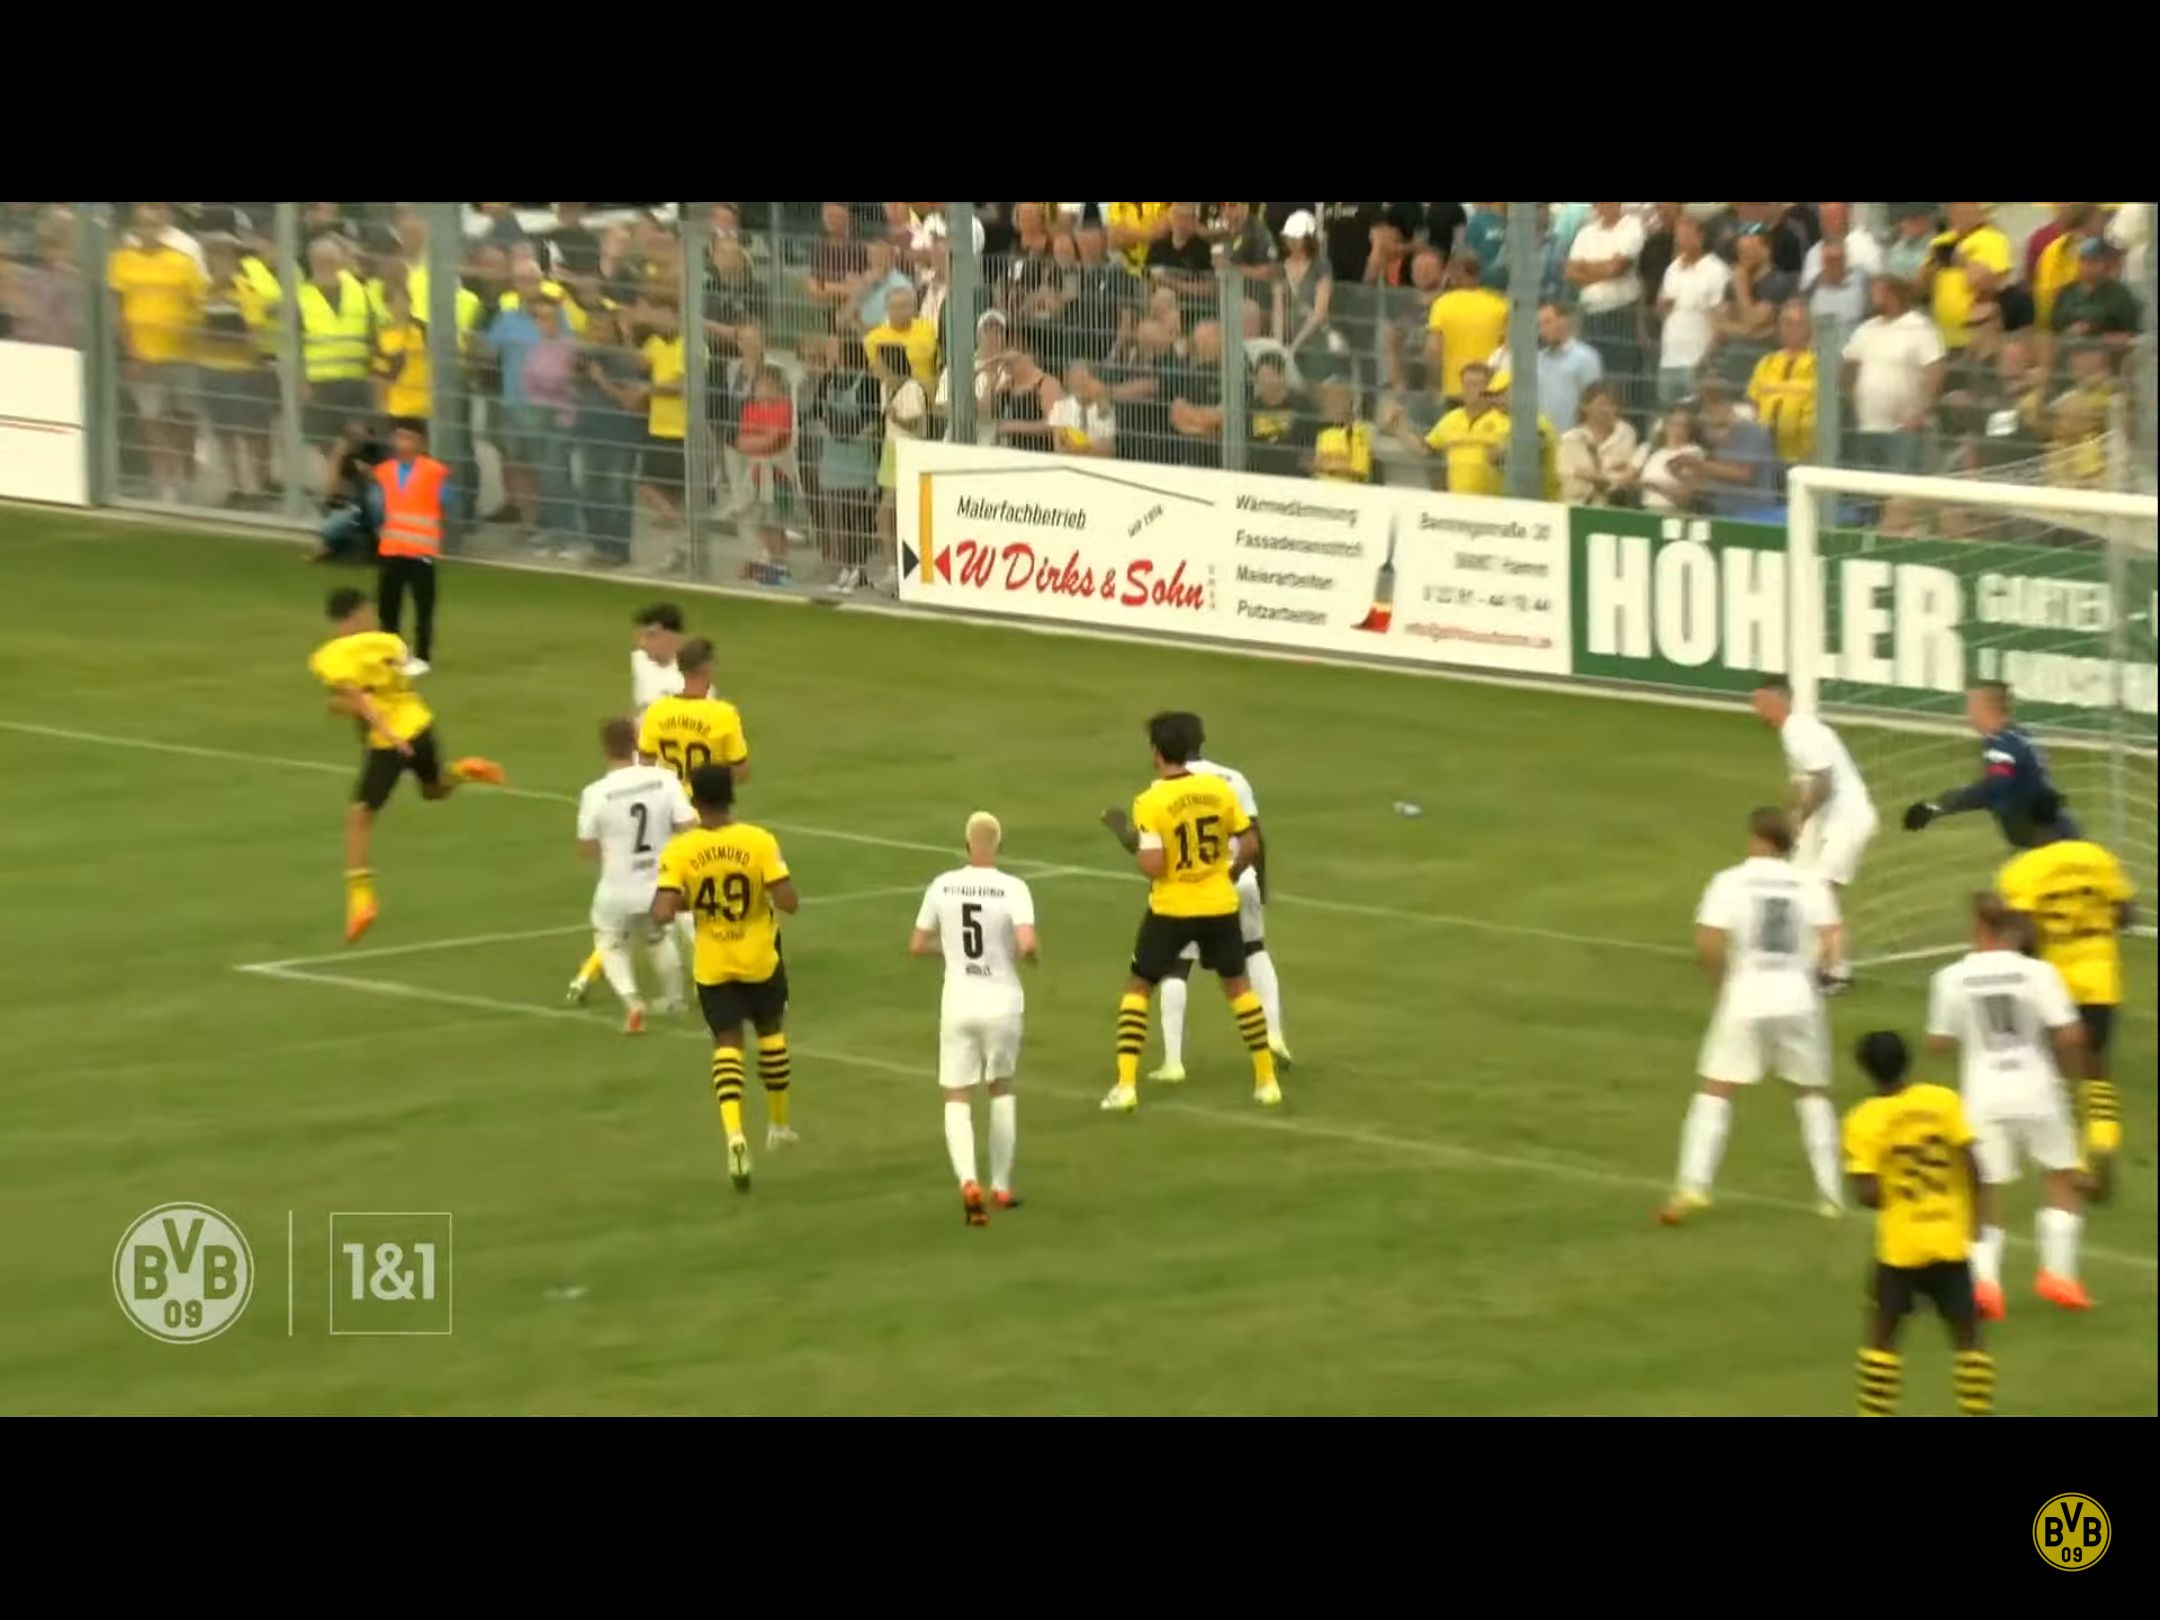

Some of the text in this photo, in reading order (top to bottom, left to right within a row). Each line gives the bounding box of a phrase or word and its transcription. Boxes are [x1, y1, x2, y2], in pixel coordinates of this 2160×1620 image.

[956, 495, 1087, 531] Malerfachbetrieb
[956, 539, 996, 589] W
[1002, 543, 1095, 598] Dirks
[1101, 567, 1116, 600] &
[1120, 559, 1205, 611] Sohn
[1587, 518, 1966, 692] HÖHLER
[629, 802, 652, 854] 2
[1174, 814, 1221, 873] 15
[689, 845, 751, 871] DORTMUND
[694, 872, 751, 923] 49
[962, 902, 984, 960] 5
